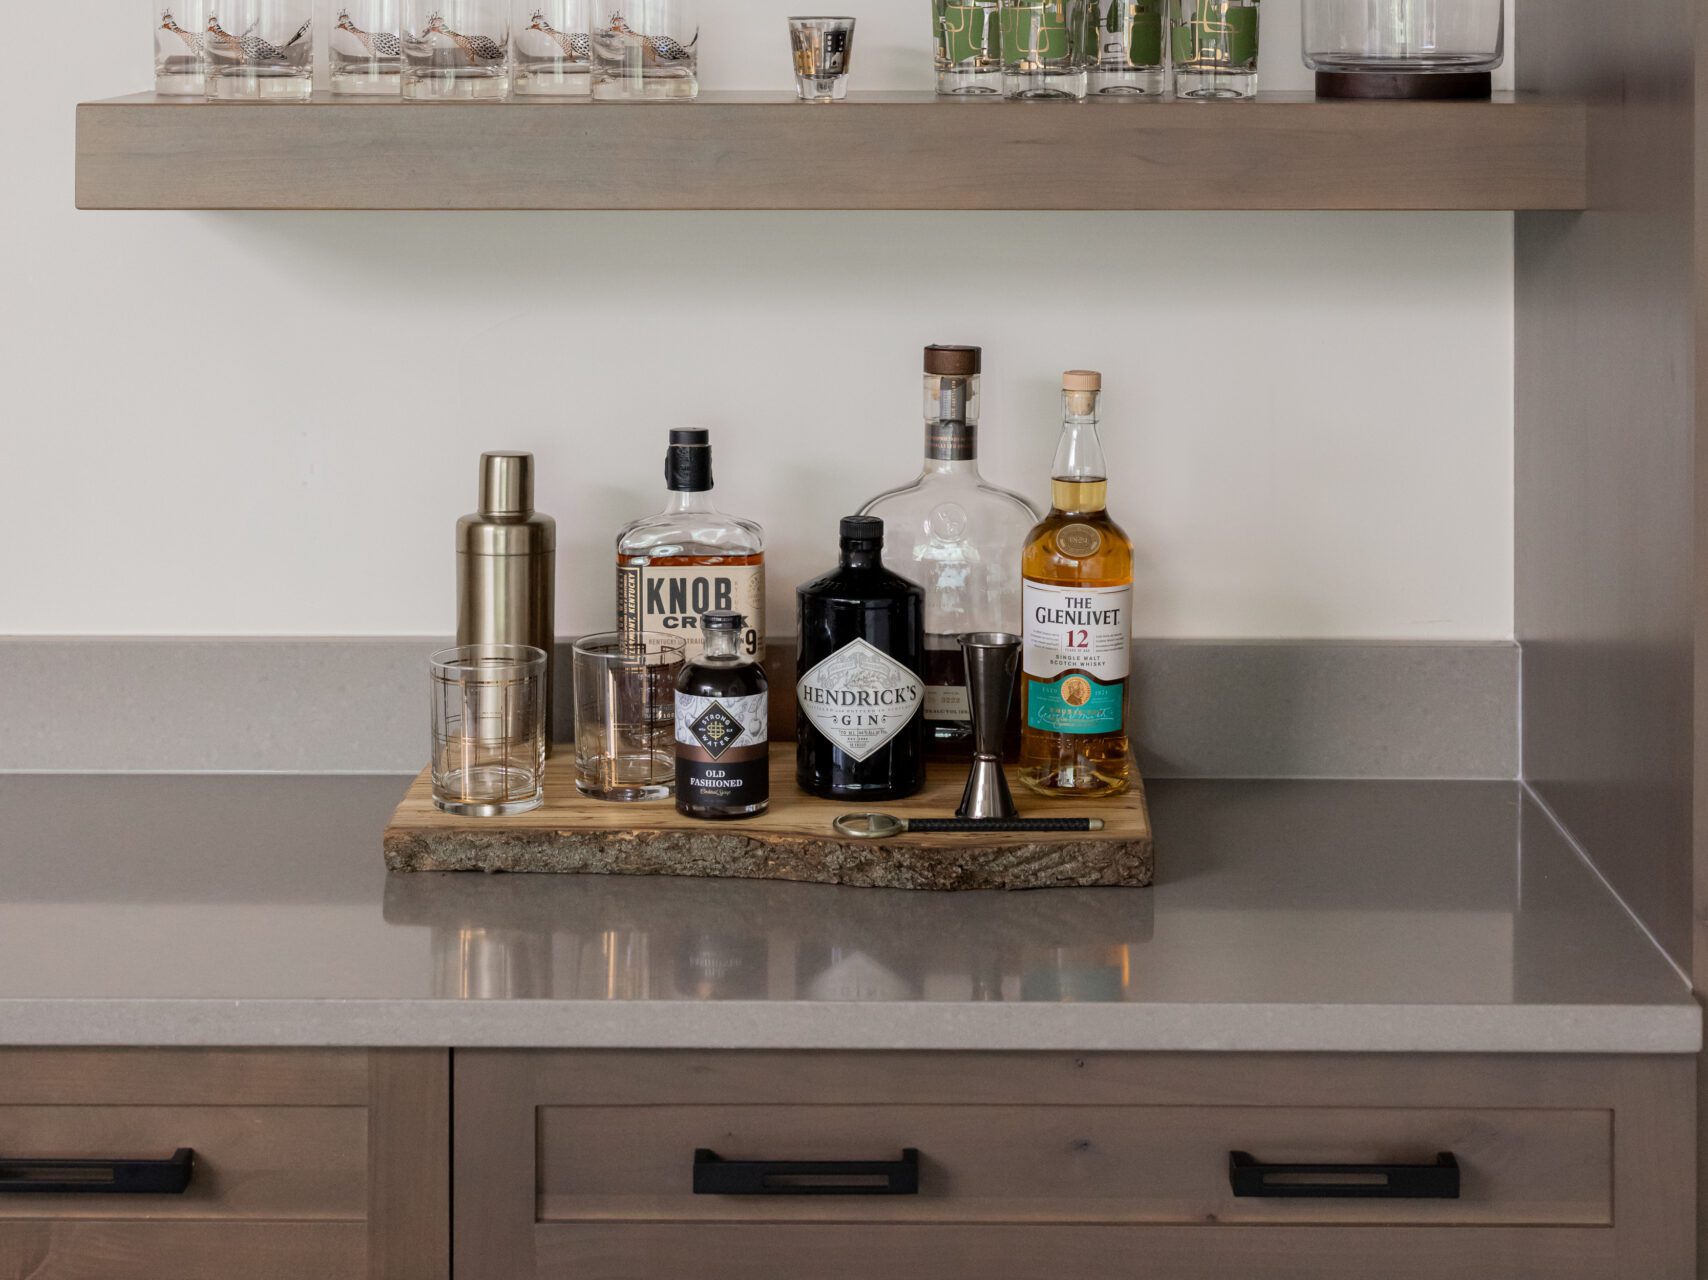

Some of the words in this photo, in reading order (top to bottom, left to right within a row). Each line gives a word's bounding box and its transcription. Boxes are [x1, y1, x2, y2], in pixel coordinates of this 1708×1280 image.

[628, 572, 637, 611] KENTUCKY
[647, 577, 732, 615] KNOB
[1064, 596, 1093, 609] THE
[663, 616, 749, 629] CRK
[745, 629, 757, 655] 9
[1066, 629, 1089, 648] 12
[803, 684, 917, 706] HENDRICK'S
[701, 713, 731, 726] STRONG
[841, 714, 879, 726] GIN
[701, 734, 730, 748] WATER
[705, 770, 726, 778] OLD
[690, 777, 743, 788] FASHIONED
